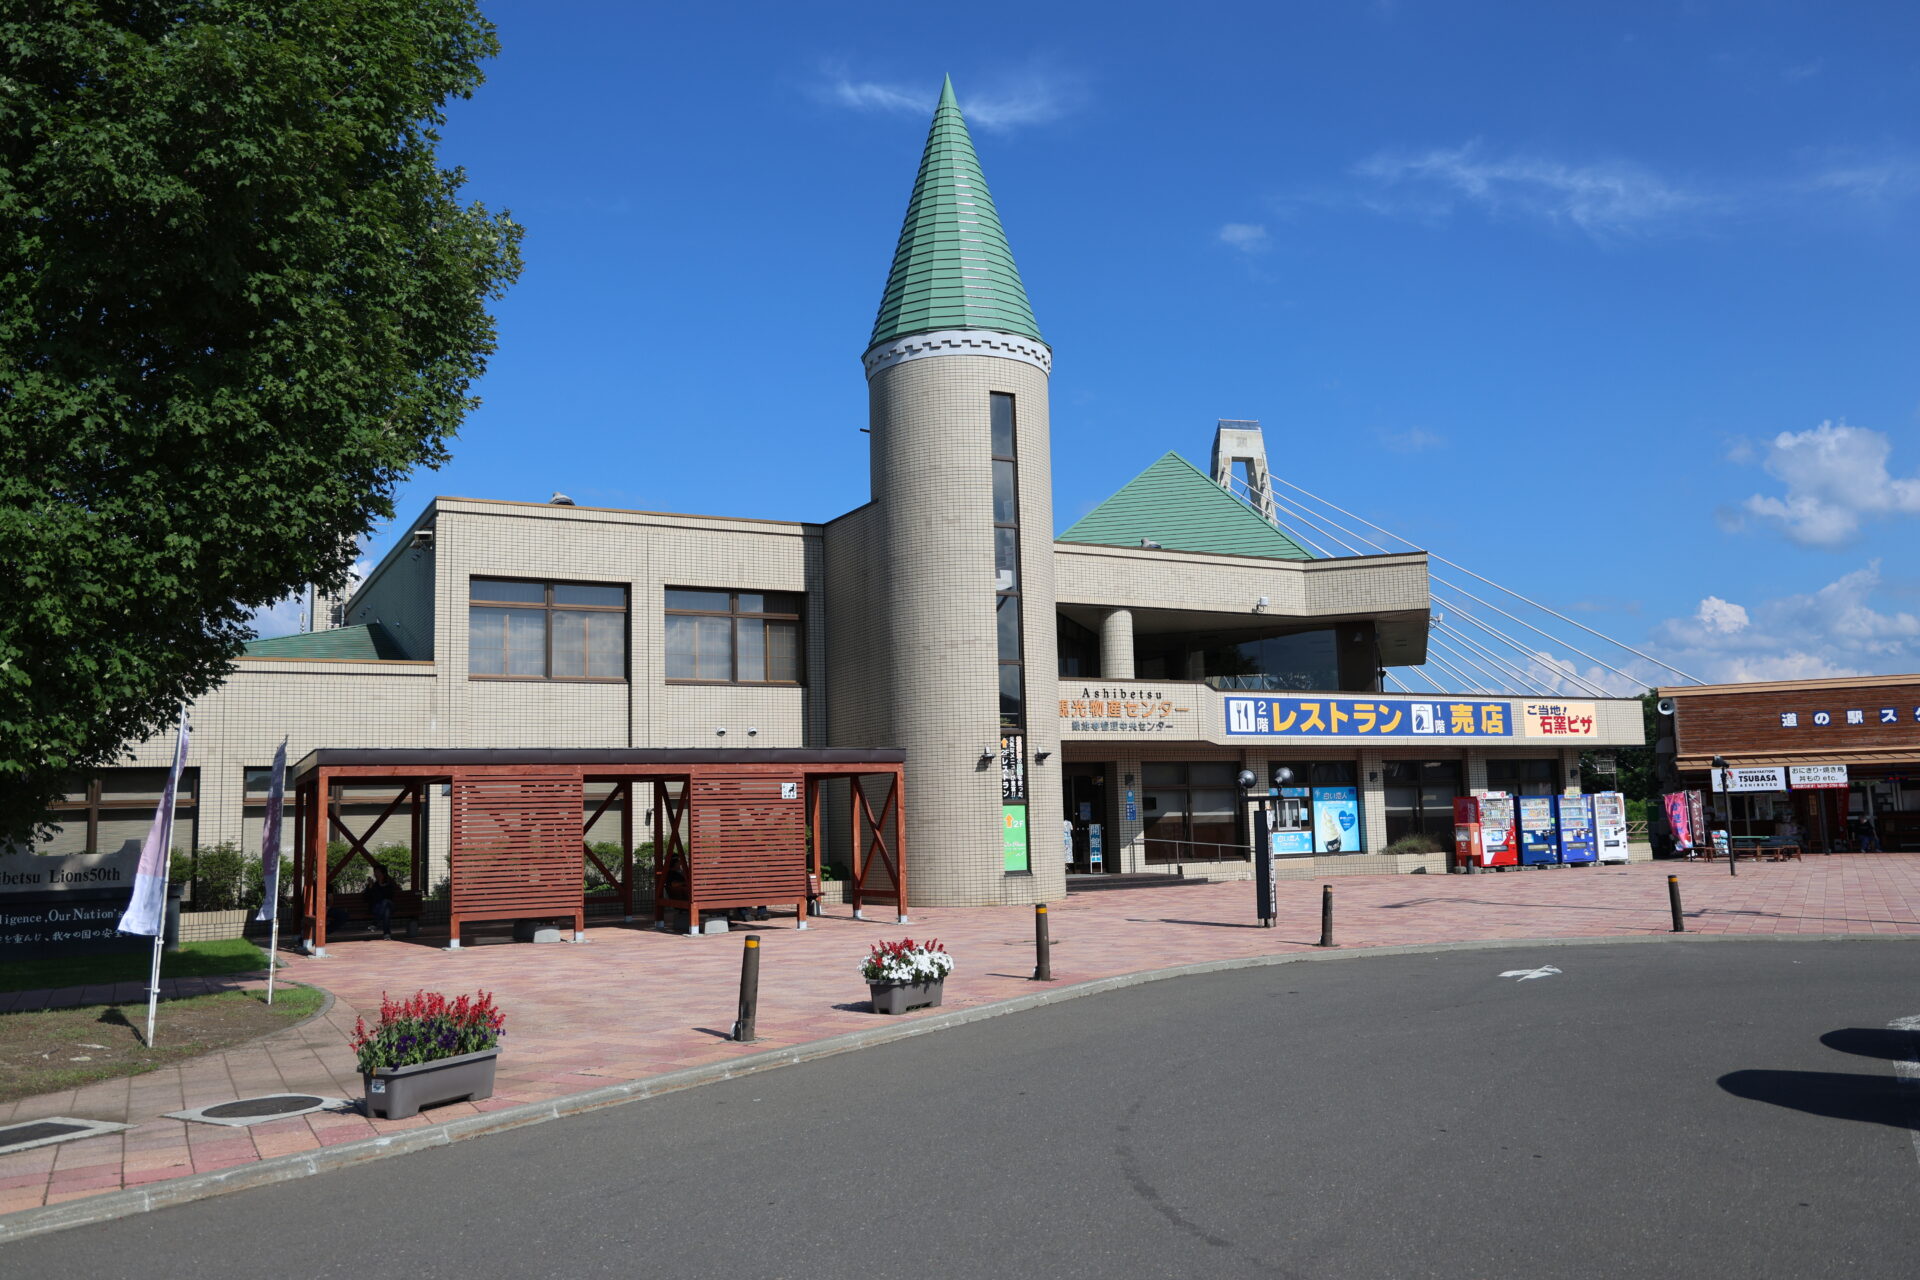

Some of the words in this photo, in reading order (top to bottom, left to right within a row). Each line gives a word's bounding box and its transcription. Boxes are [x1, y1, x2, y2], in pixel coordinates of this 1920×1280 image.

[1082, 687, 1162, 699] Ashibetsu
[1272, 702, 1402, 733] レストラン
[1449, 704, 1504, 734] 売店
[1539, 715, 1593, 734] 石窯ピザ
[1738, 774, 1777, 782] TSUBASA
[1013, 820, 1024, 828] 2F
